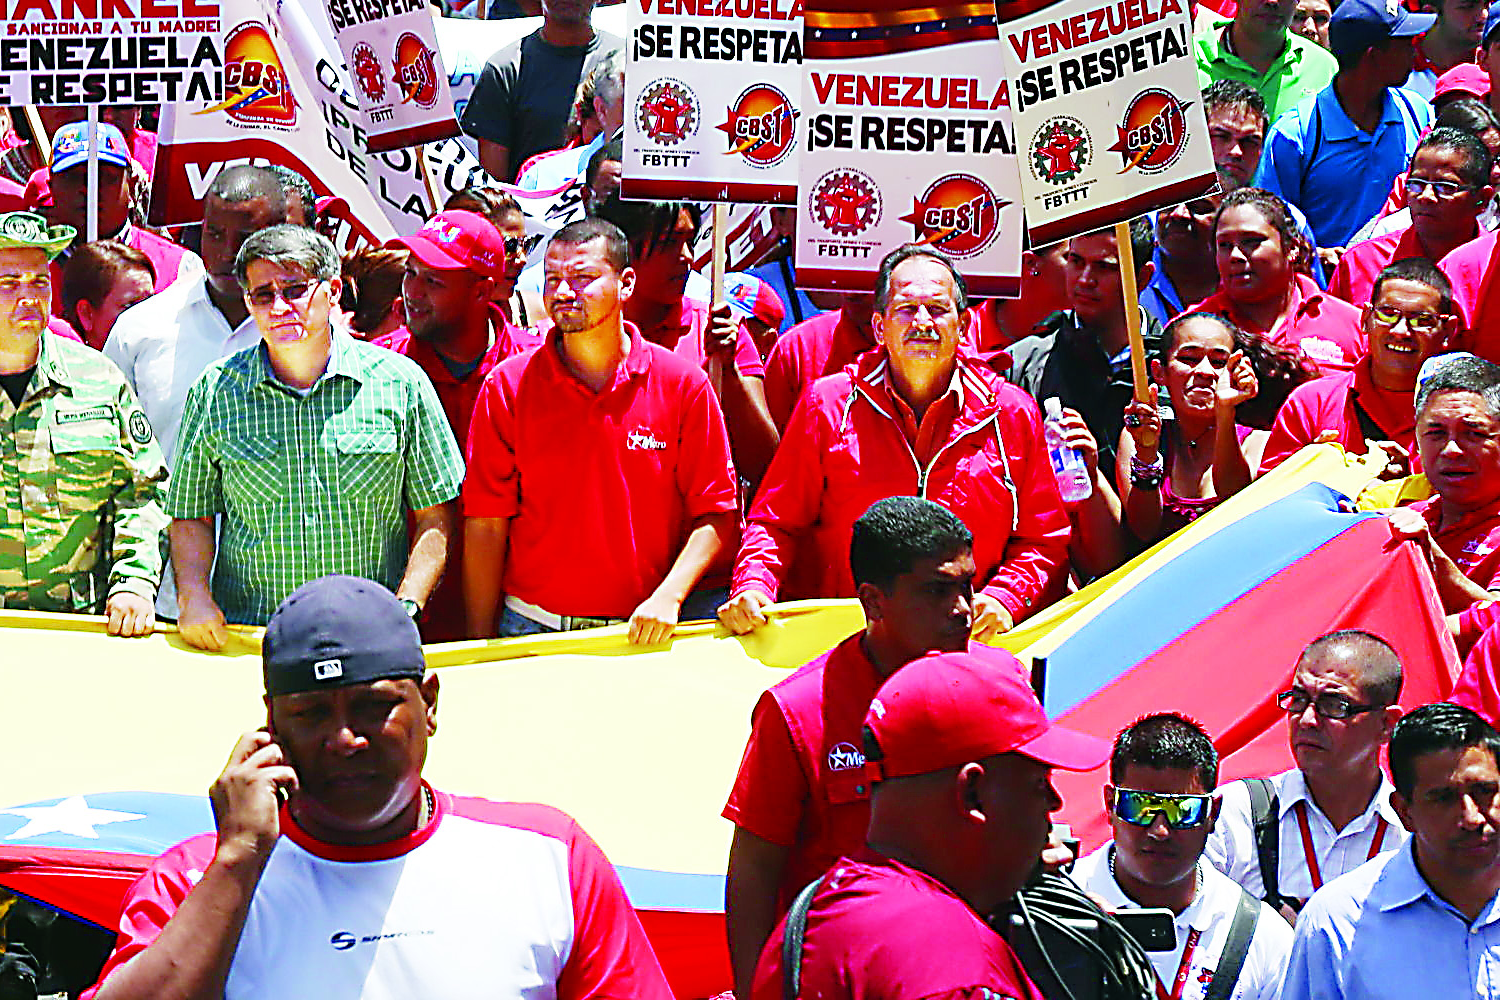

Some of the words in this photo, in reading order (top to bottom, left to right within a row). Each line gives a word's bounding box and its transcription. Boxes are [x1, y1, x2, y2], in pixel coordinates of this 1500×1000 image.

[6, 21, 103, 37] SANCIONAR
[111, 21, 122, 34] A
[132, 21, 152, 34] TU
[1015, 71, 1057, 113] ¡SE
[1058, 23, 1189, 95] RESPETA!
[36, 71, 223, 108] RESPETA!
[810, 72, 1011, 111] VENEZUELA
[735, 103, 783, 149] CBST
[1128, 101, 1177, 155] CBST
[325, 127, 369, 185] DE
[379, 183, 432, 225] LA
[642, 154, 691, 168] FBTTT
[1042, 186, 1089, 211] FBTTT
[922, 194, 989, 249] CBST
[818, 244, 872, 259] FBTTT
